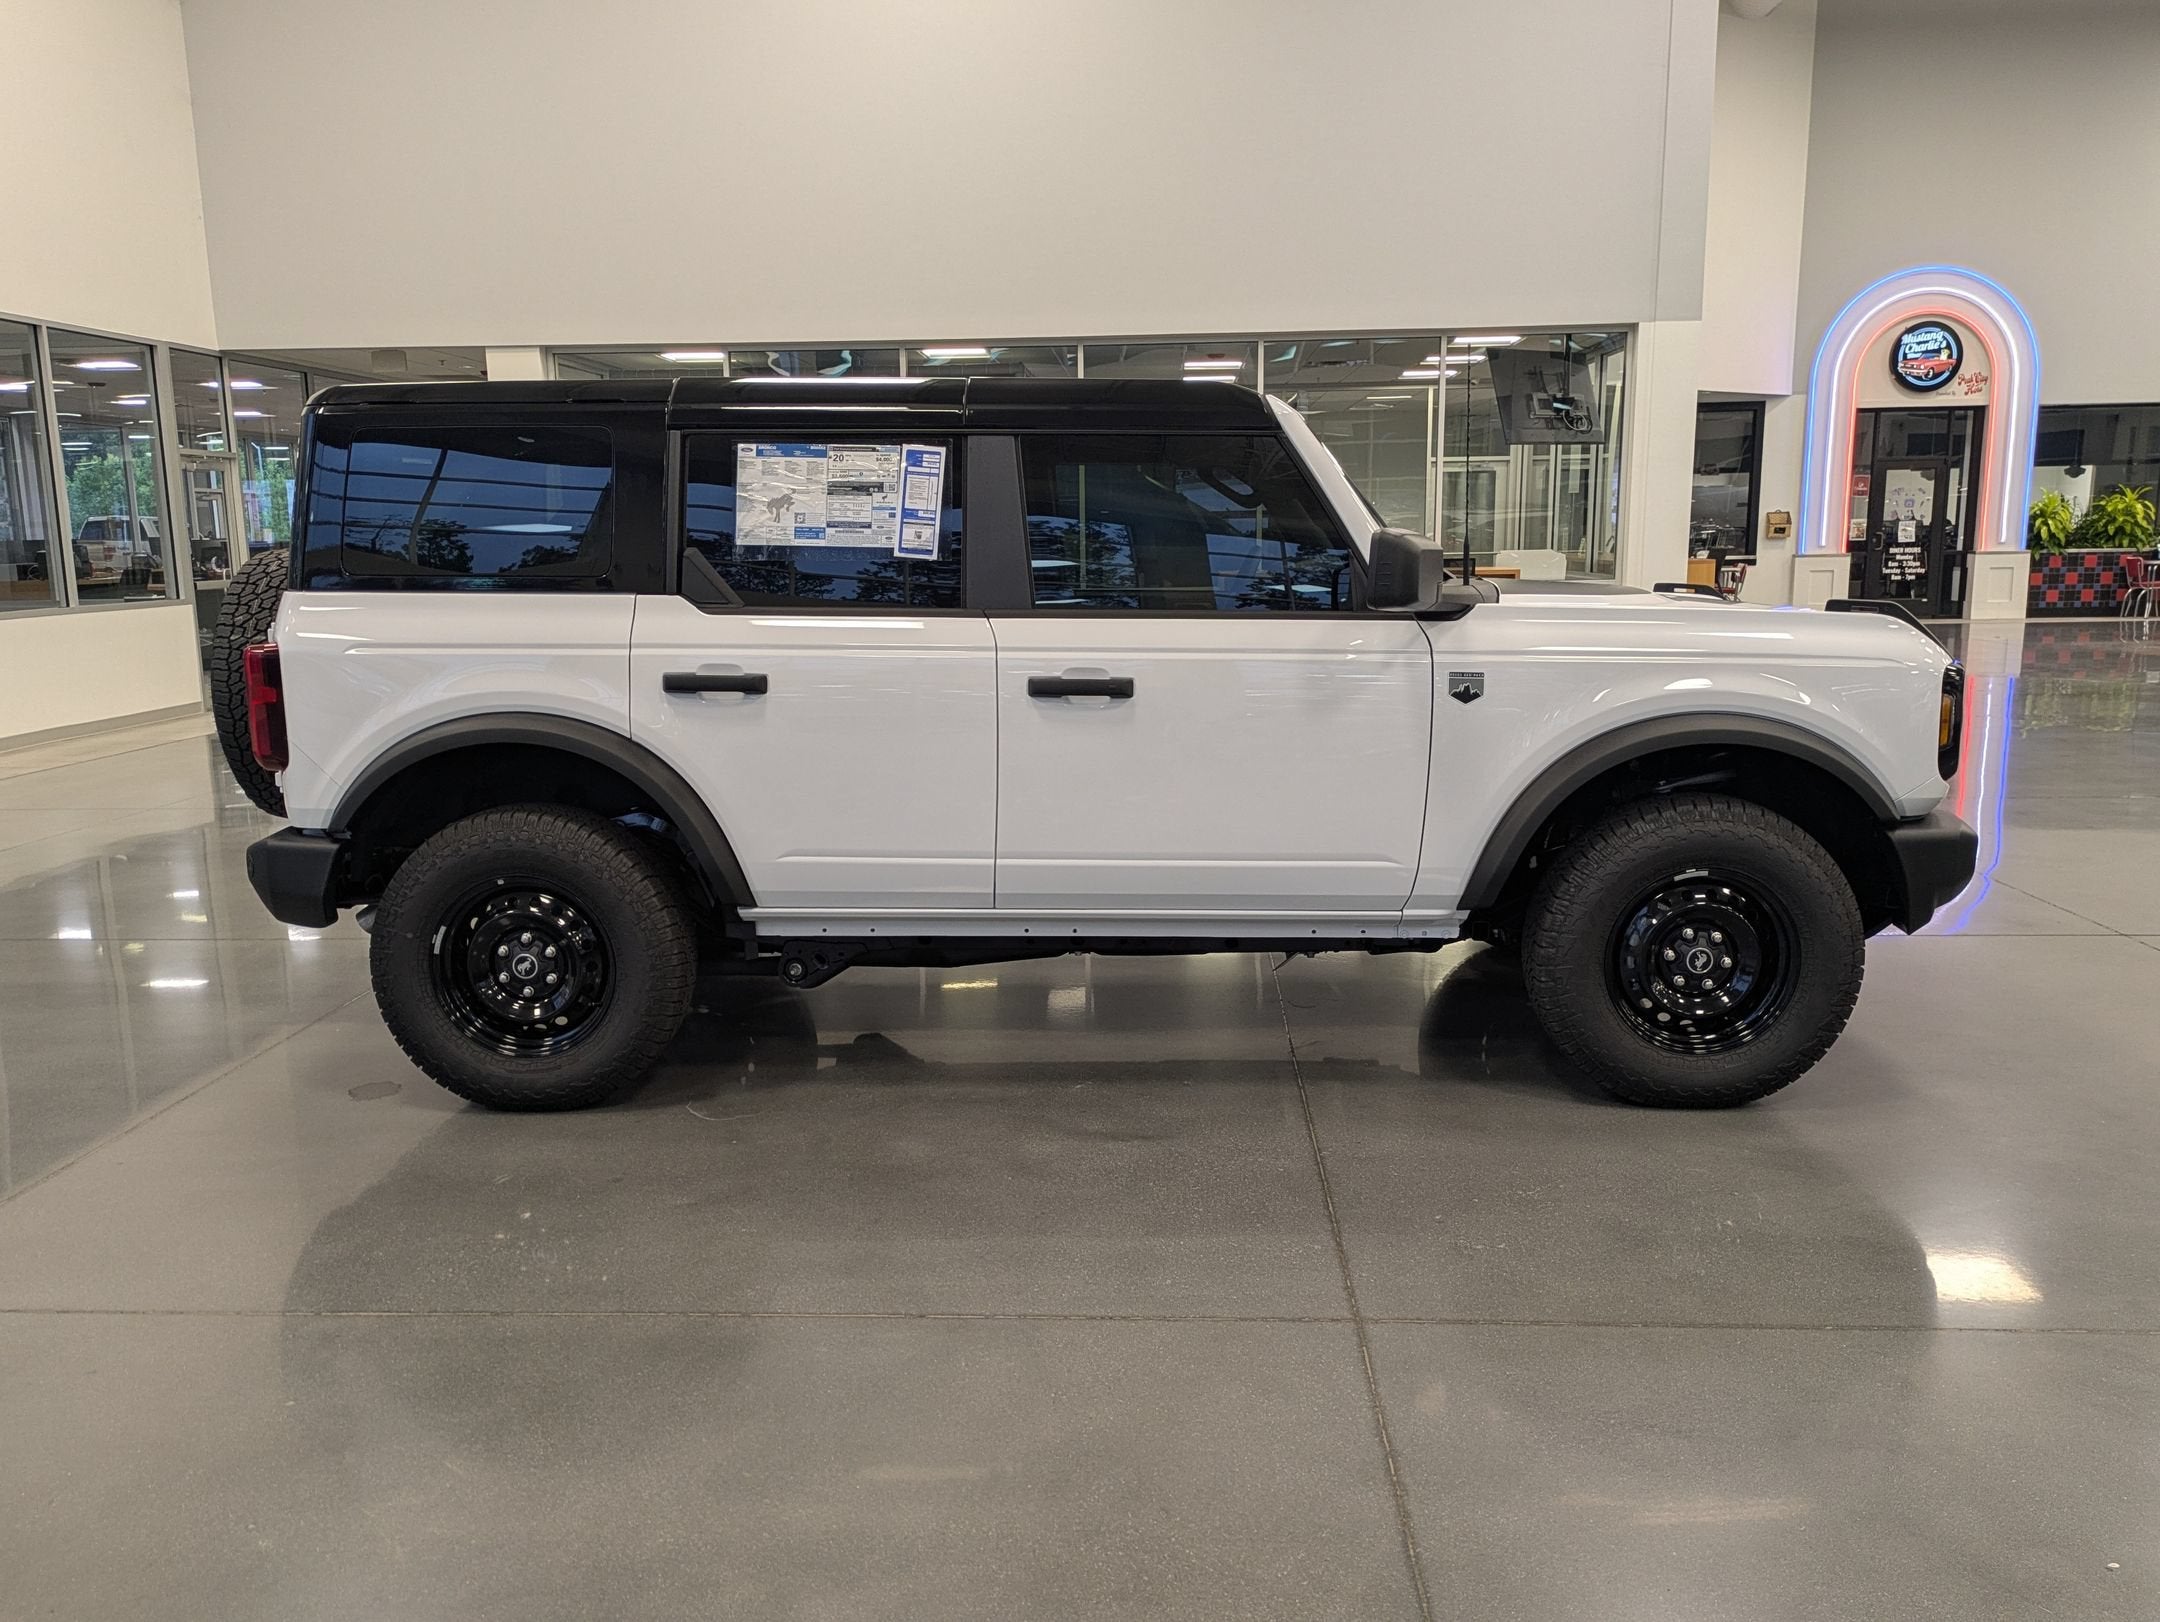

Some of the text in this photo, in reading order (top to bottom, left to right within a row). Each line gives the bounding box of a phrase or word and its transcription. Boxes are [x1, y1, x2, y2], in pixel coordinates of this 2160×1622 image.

[1901, 331, 1944, 344] Mustang
[1905, 340, 1947, 353] Charlie's
[833, 454, 844, 462] 20
